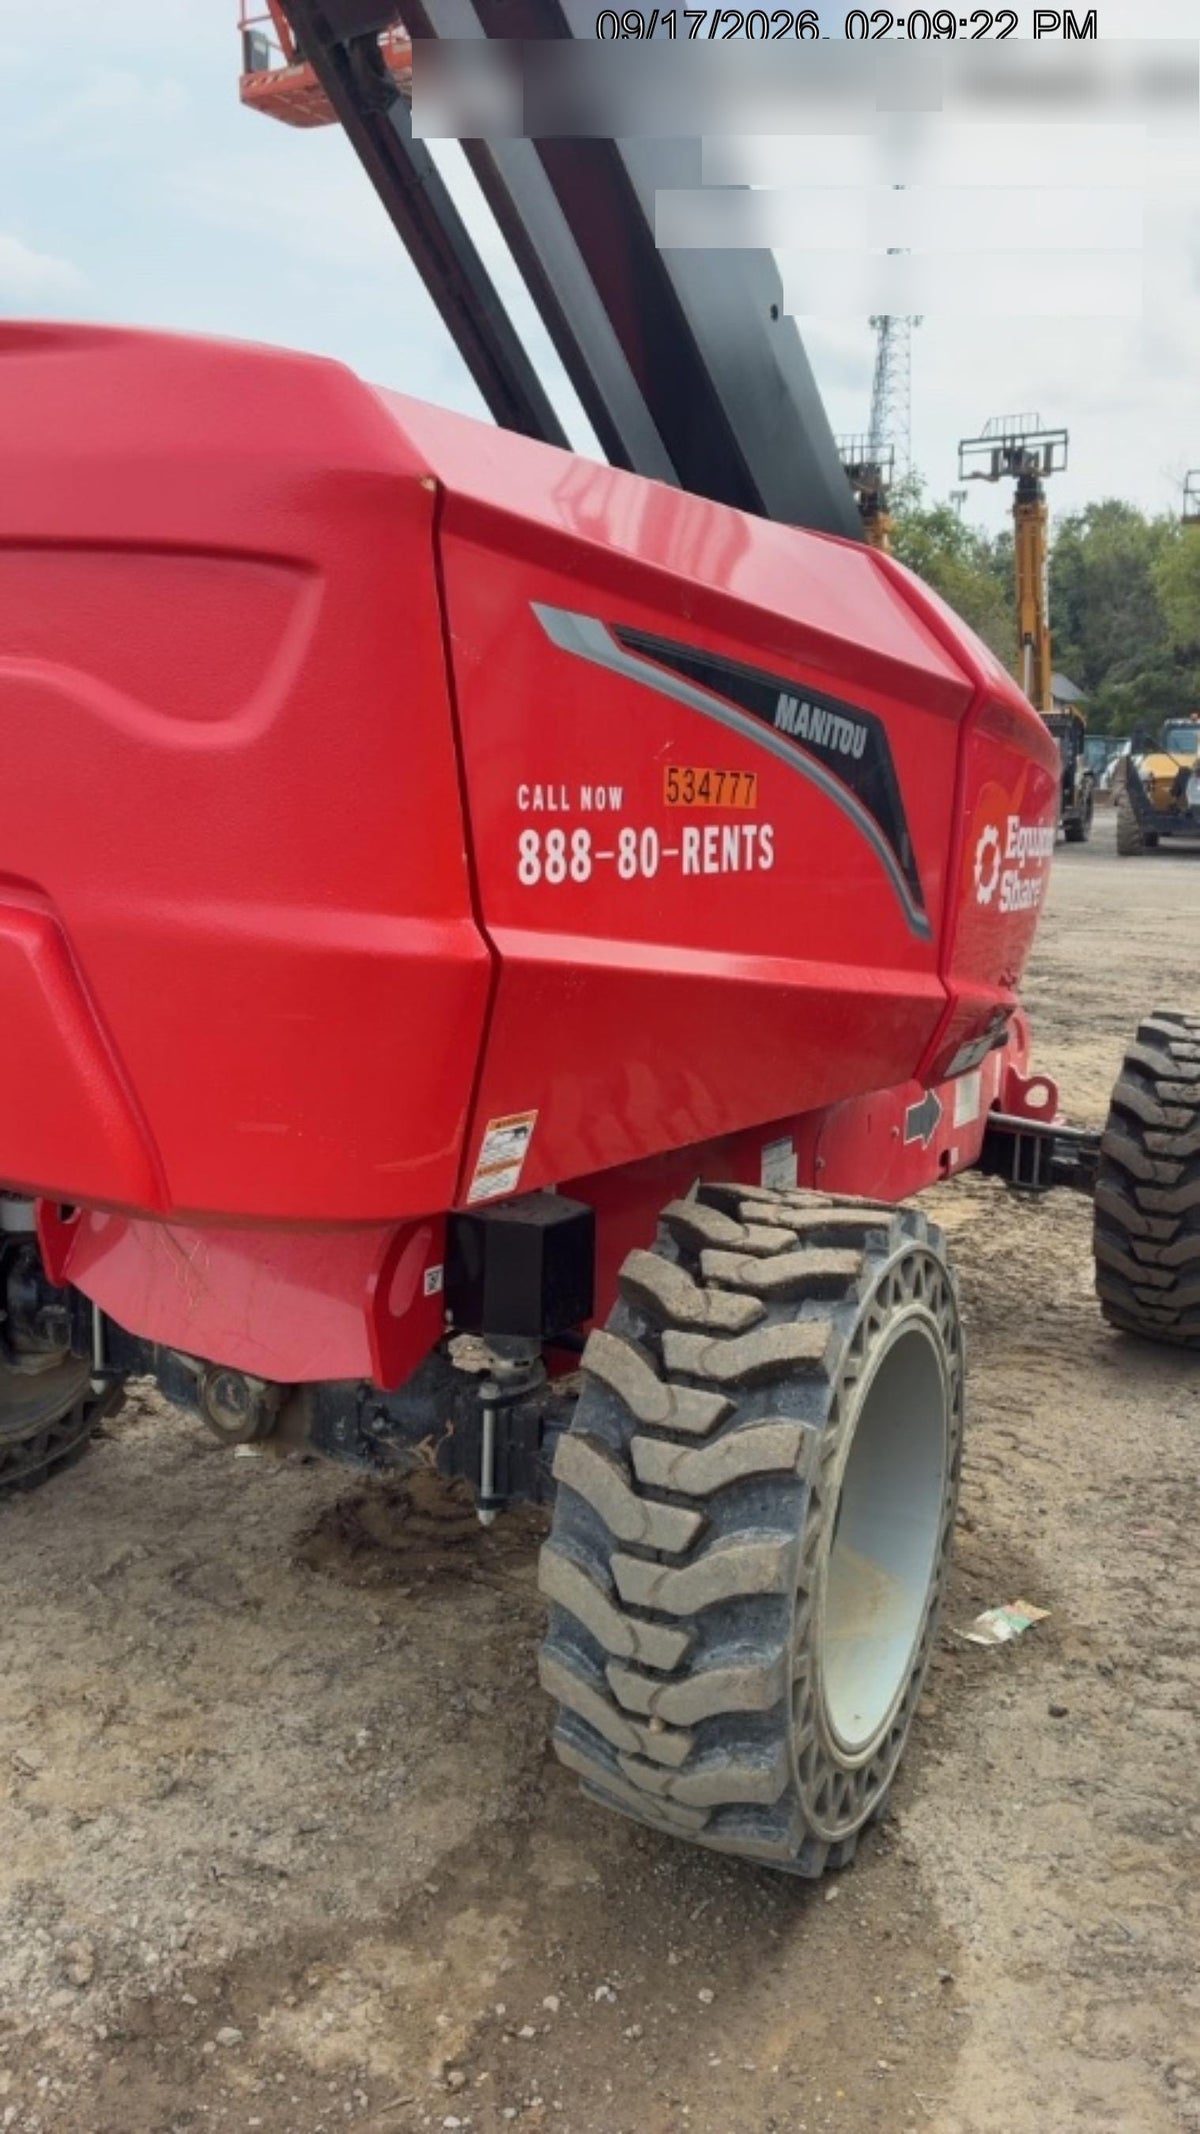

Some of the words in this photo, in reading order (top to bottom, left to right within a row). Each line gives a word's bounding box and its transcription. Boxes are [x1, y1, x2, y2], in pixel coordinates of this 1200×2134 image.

[775, 693, 868, 759] MANITOU
[517, 784, 570, 811] CALL
[580, 786, 623, 810] NOW
[666, 767, 756, 806] 534777
[518, 824, 775, 885] 888-80-RENTS
